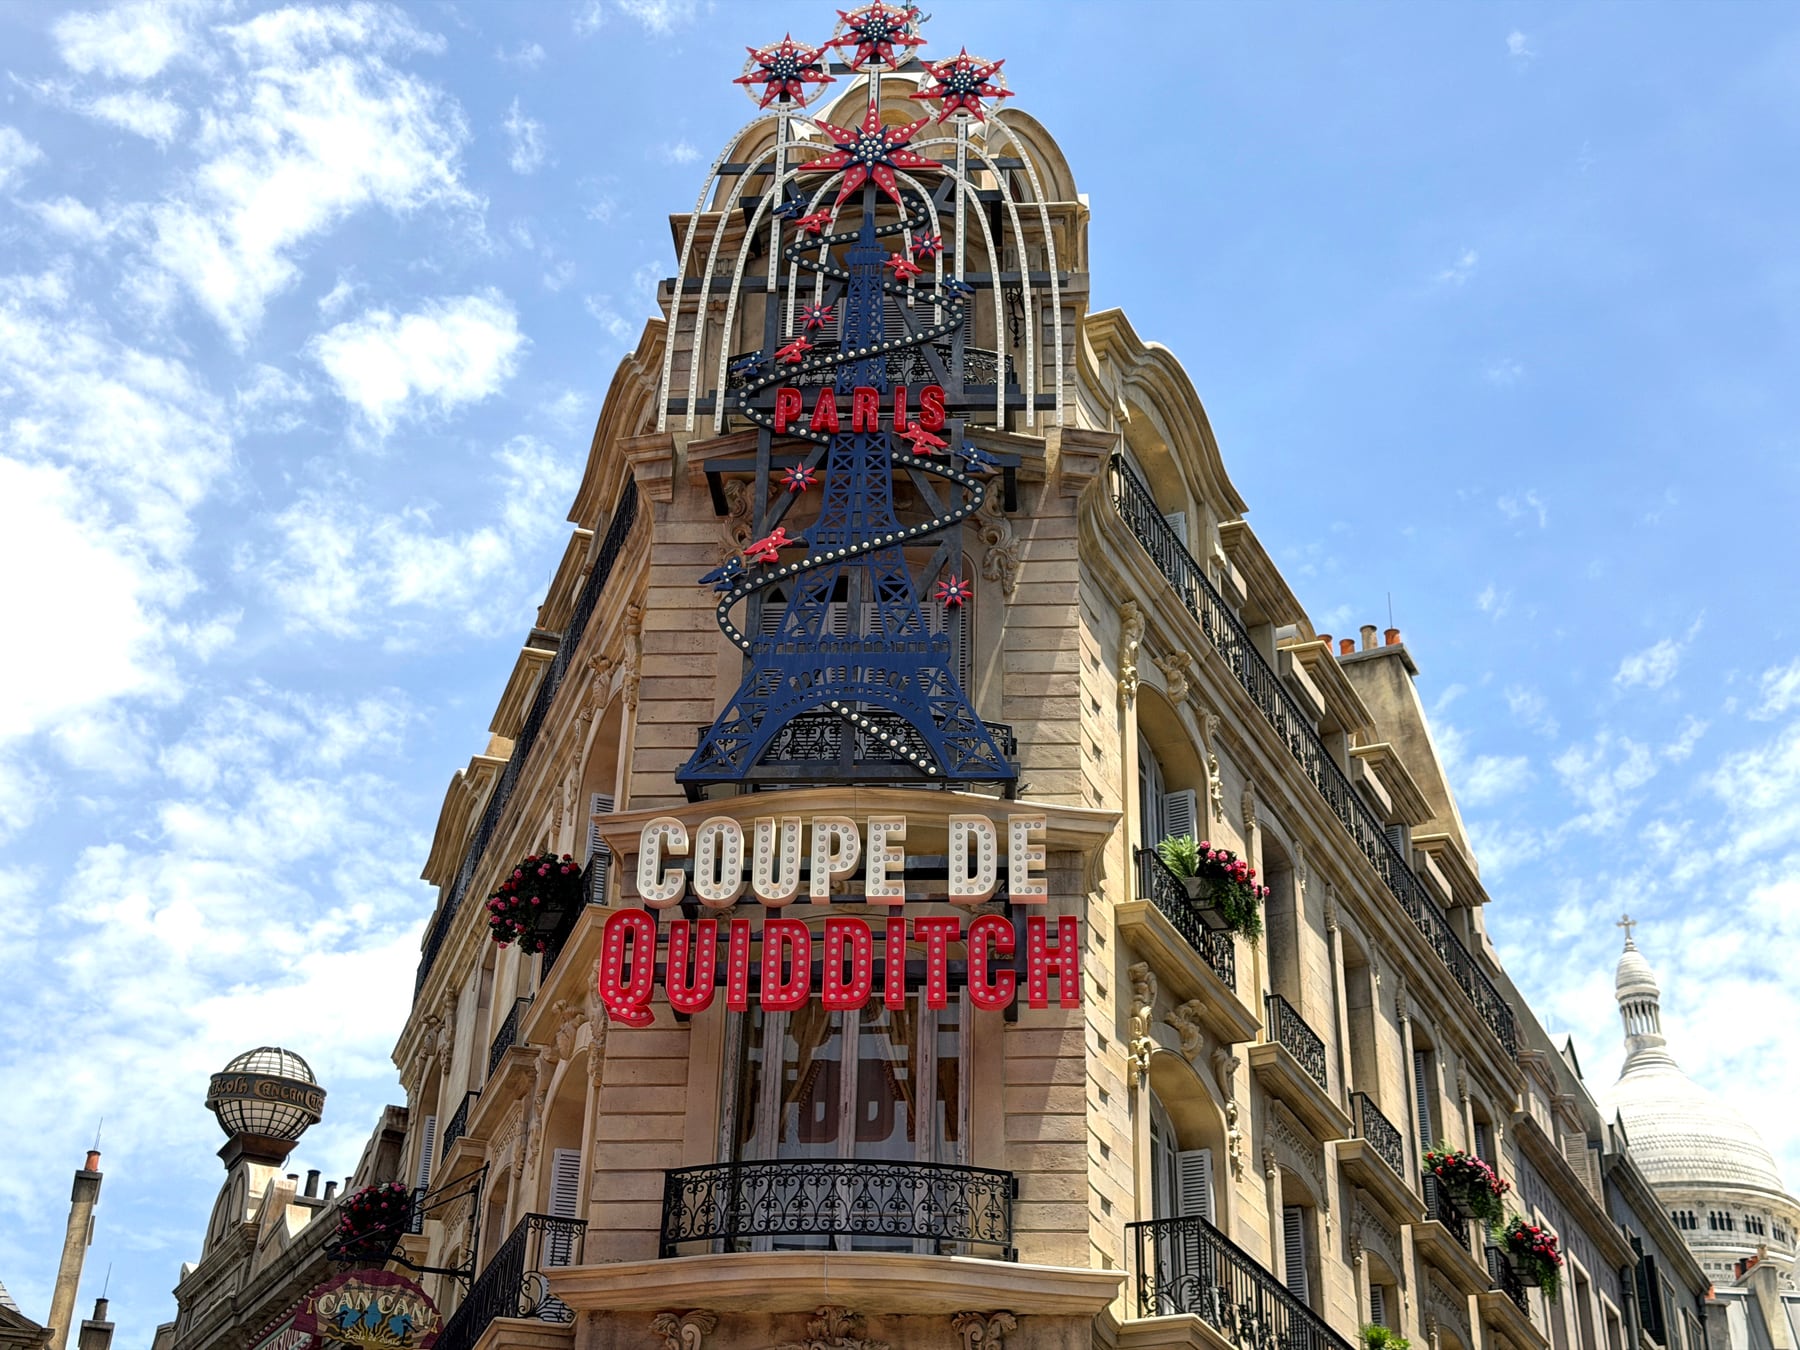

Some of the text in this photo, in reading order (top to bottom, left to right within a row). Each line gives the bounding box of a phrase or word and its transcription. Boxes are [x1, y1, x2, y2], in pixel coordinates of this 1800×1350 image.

[775, 385, 945, 433] PARIS
[637, 814, 1047, 908] COUPE DE
[598, 908, 1079, 1027] QUIDDITCH
